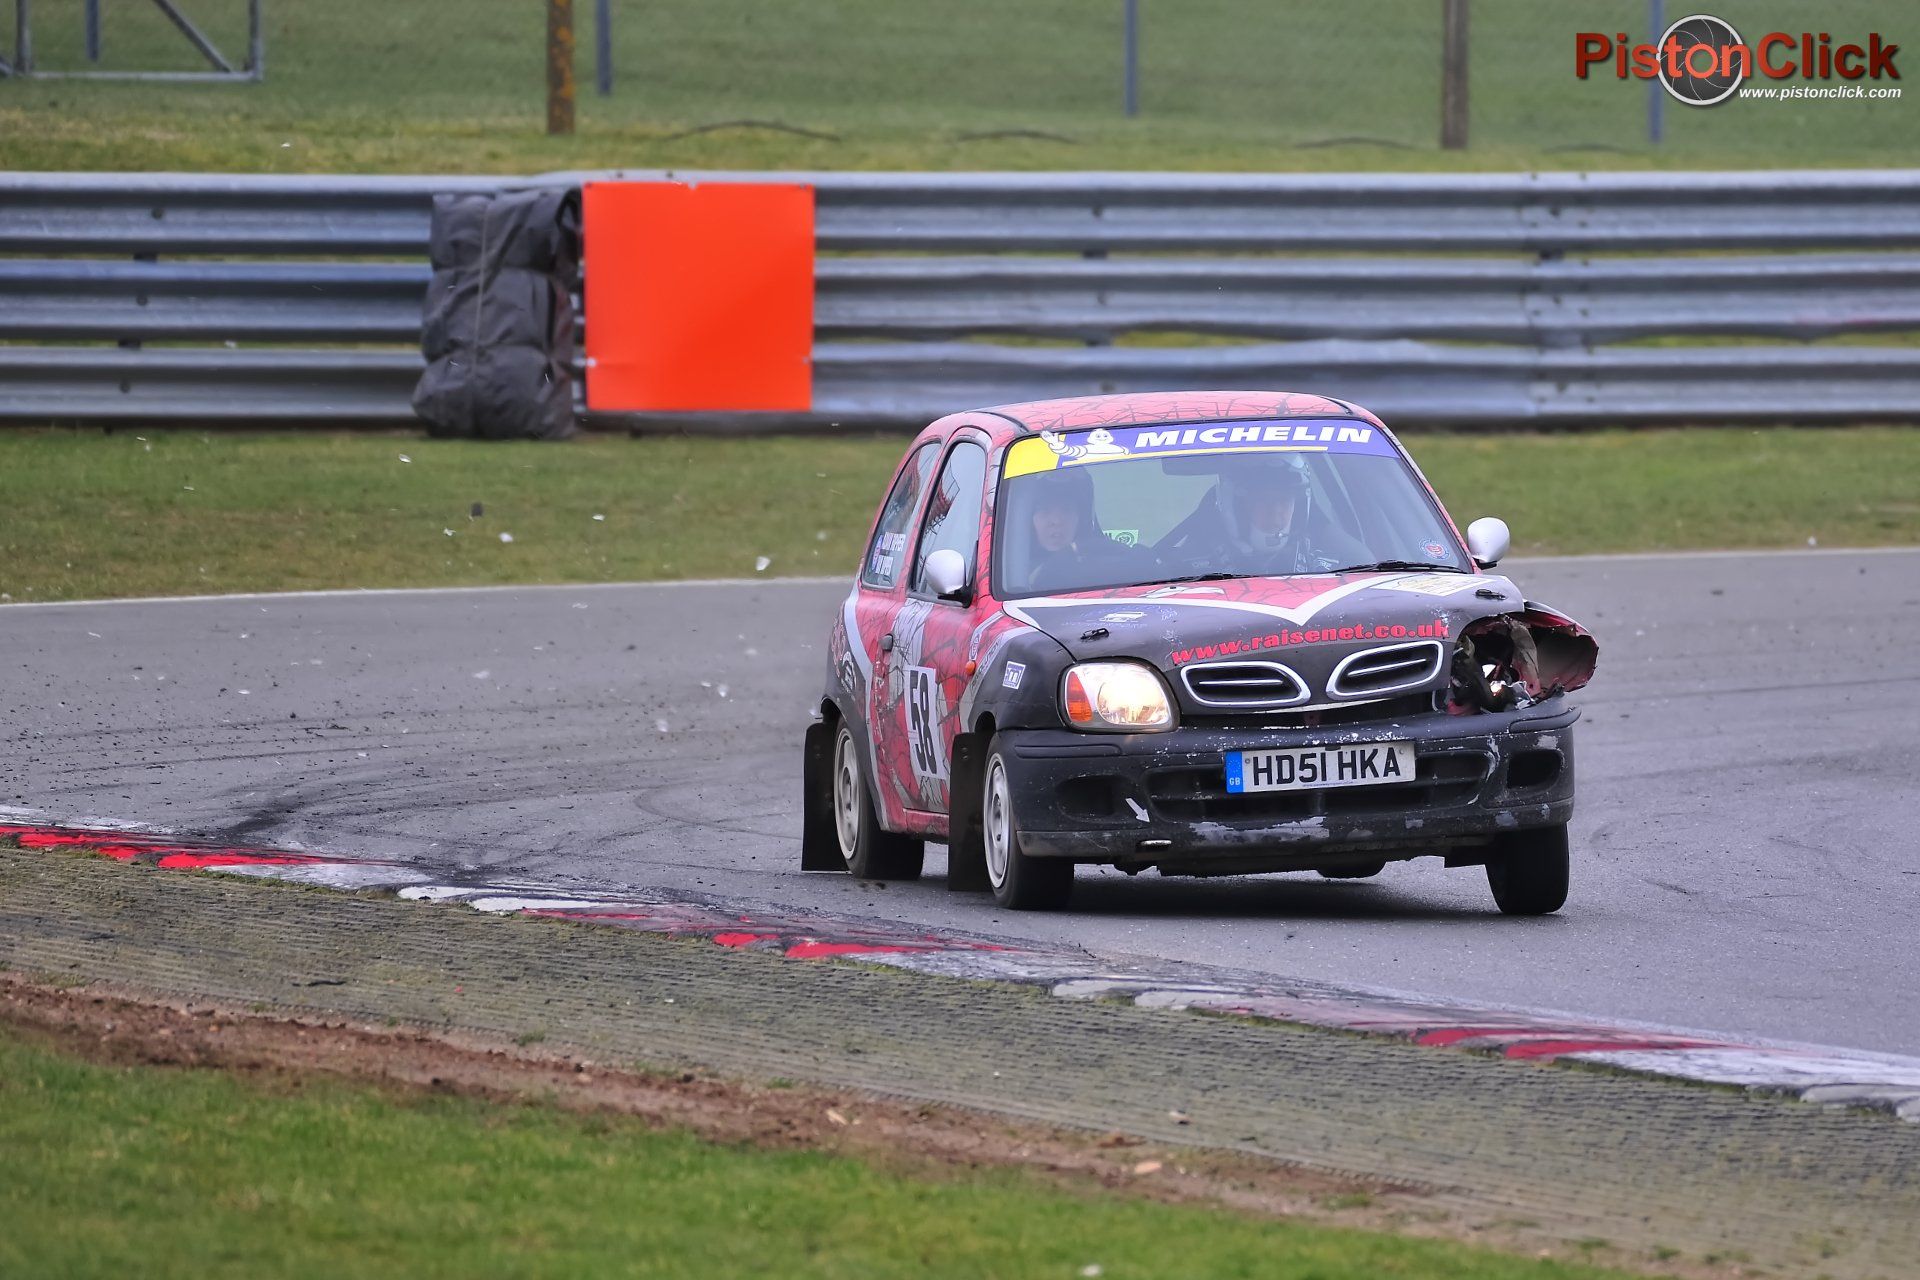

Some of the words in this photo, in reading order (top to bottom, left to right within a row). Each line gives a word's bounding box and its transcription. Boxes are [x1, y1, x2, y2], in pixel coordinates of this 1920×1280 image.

[1135, 426, 1372, 448] MICHELIN
[1171, 619, 1449, 665] www.raisenet.co.uk
[910, 669, 937, 774] 58
[1229, 777, 1241, 786] GB
[1253, 752, 1327, 786] HD51
[1338, 746, 1401, 780] HKA
